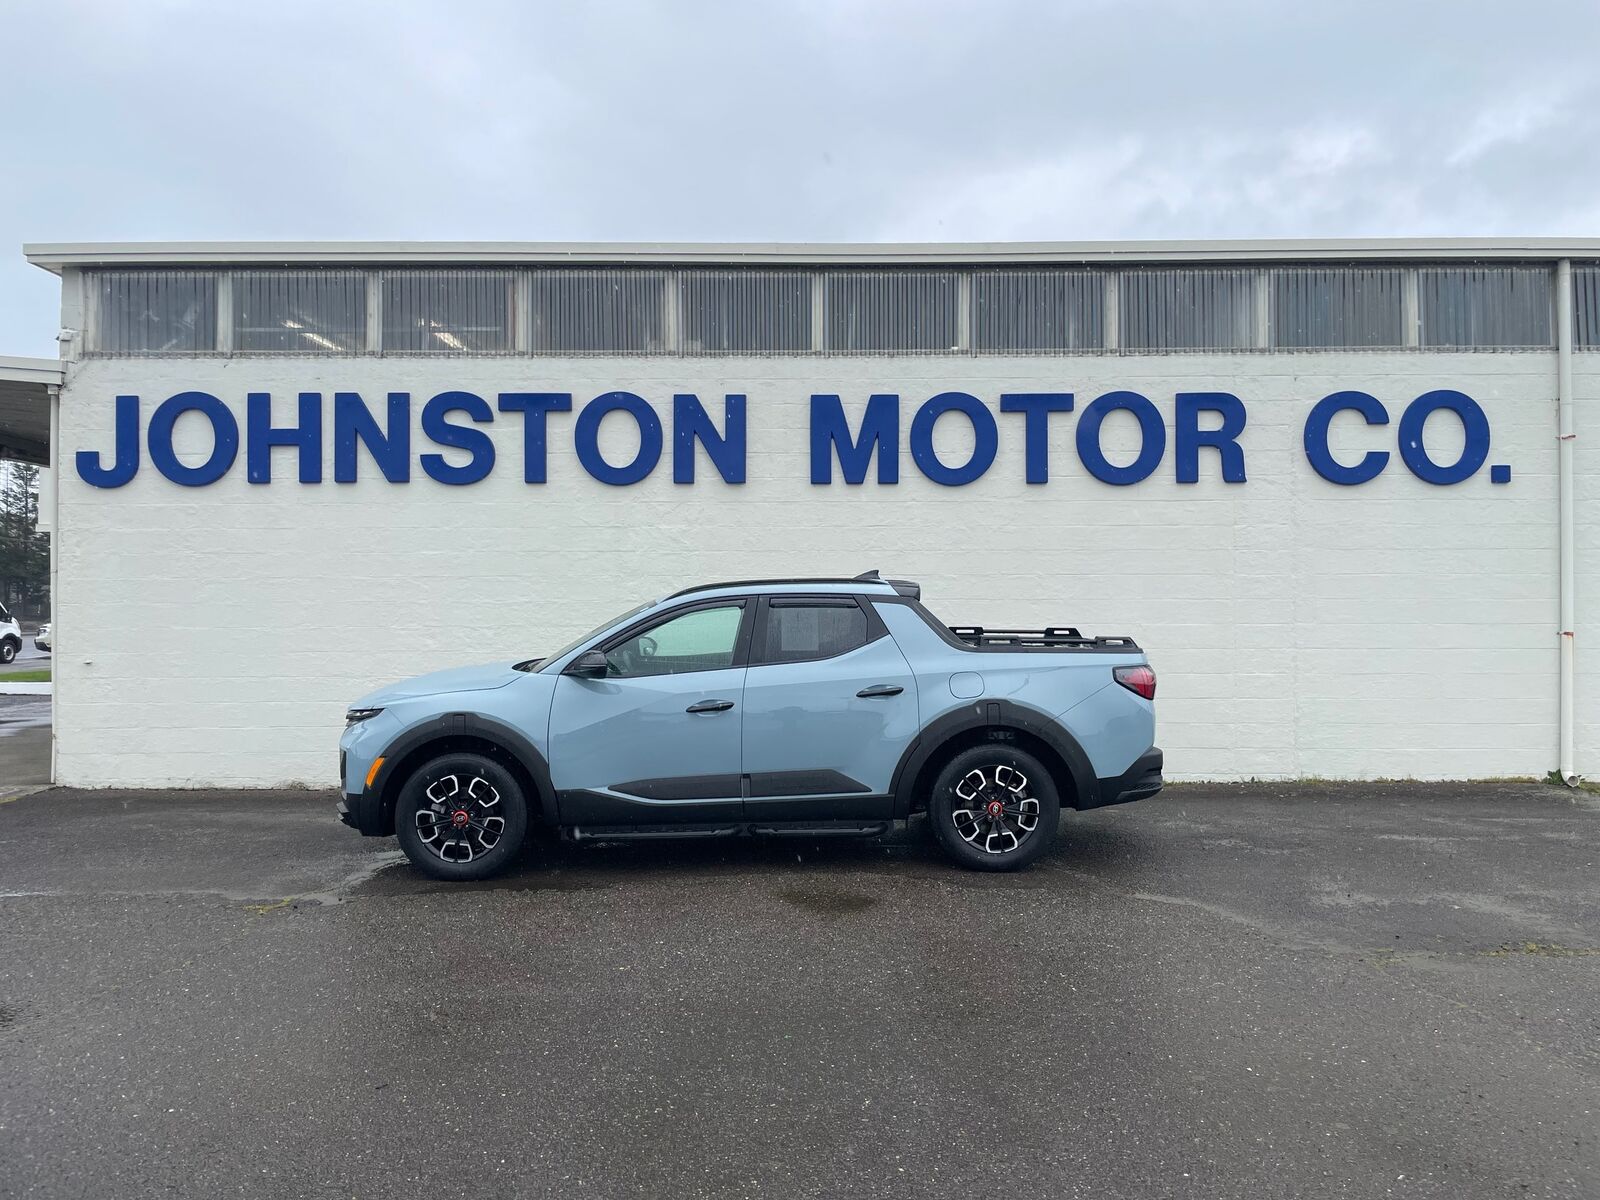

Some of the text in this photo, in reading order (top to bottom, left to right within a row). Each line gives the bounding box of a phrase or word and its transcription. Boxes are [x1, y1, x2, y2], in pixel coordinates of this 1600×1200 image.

[76, 389, 1511, 488] JOHNSTON MOTOR CO.
